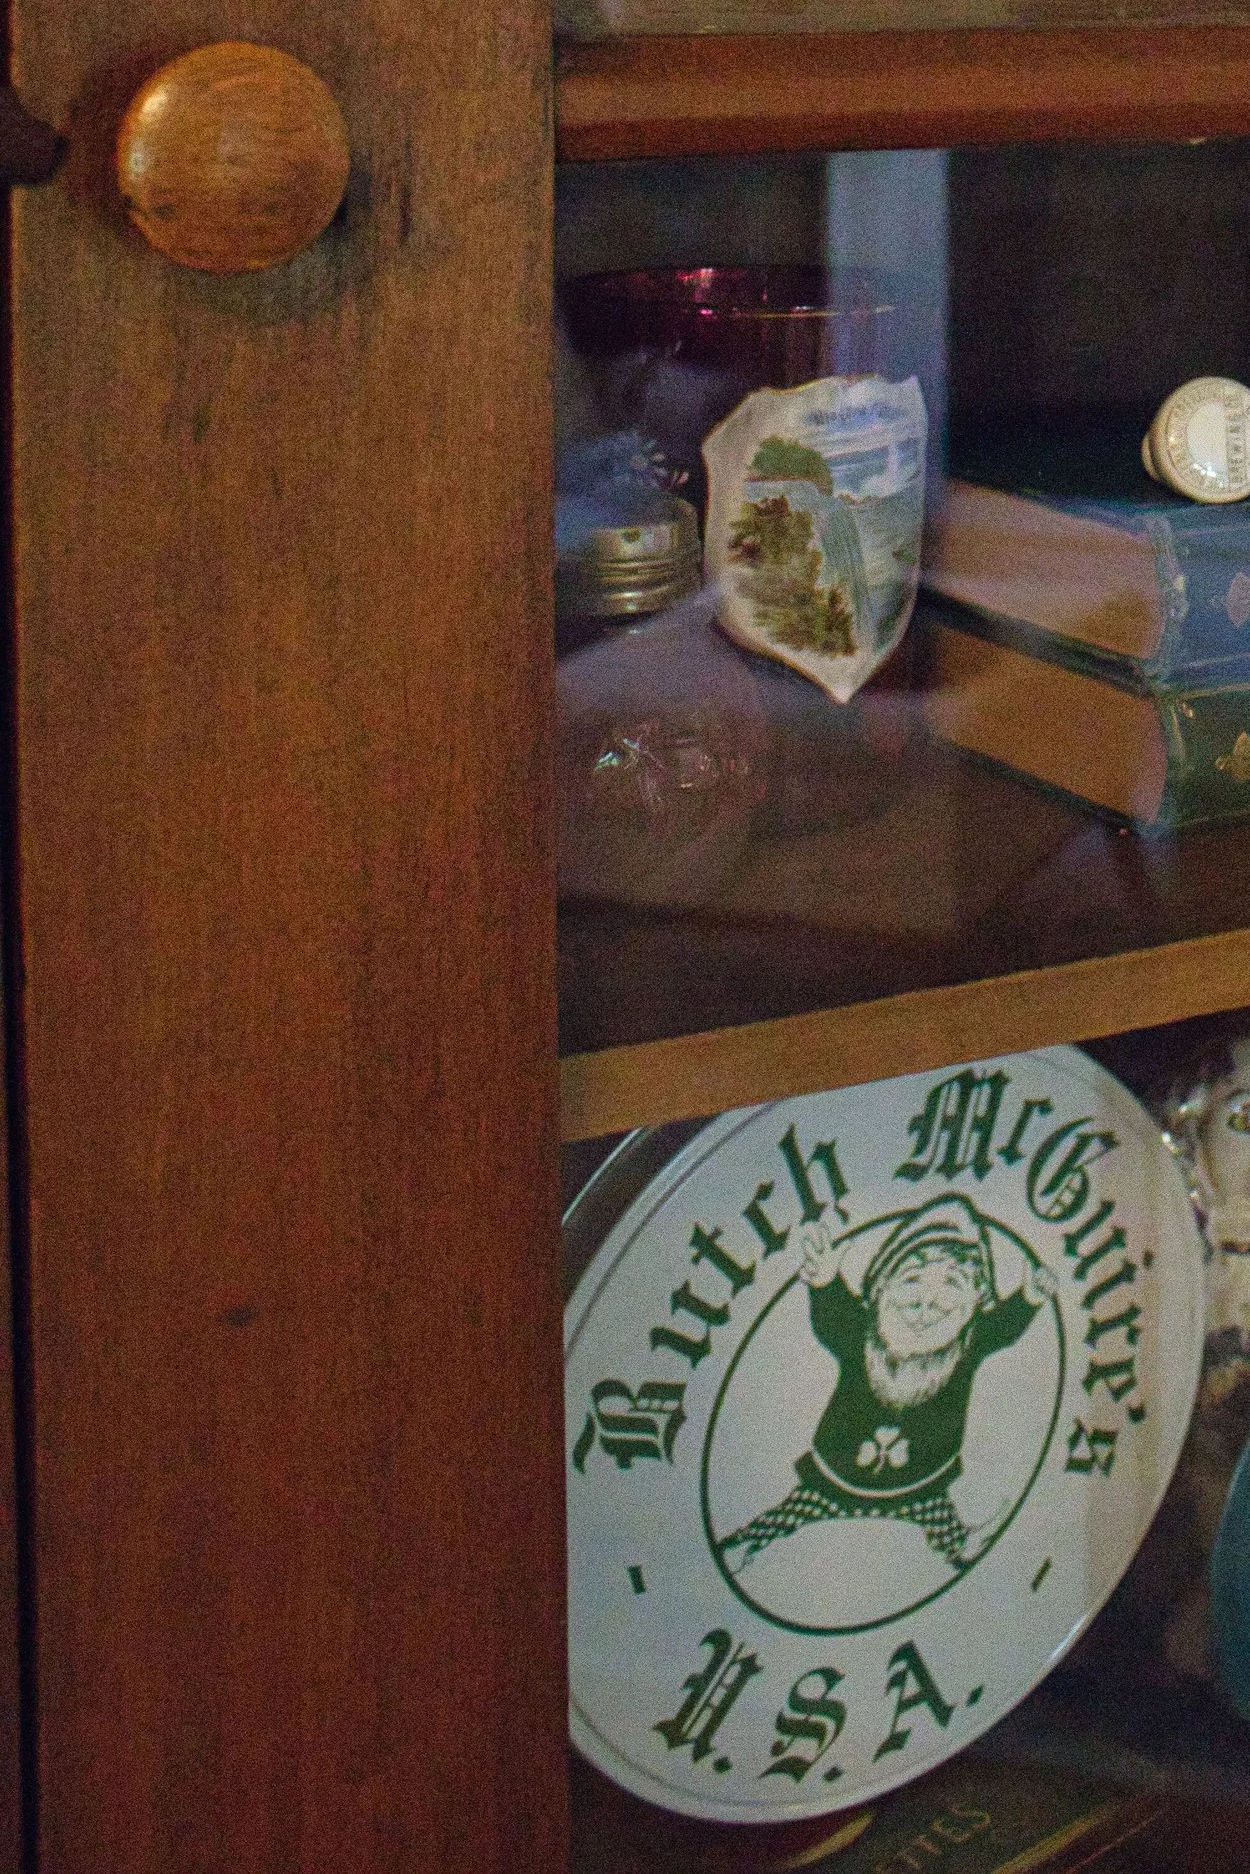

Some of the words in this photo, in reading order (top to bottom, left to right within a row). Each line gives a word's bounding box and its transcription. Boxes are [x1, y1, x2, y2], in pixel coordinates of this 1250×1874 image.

[572, 1123, 850, 1476] Butch
[892, 1066, 1156, 1478] McGuire's
[652, 1627, 985, 1784] U.S.A.
